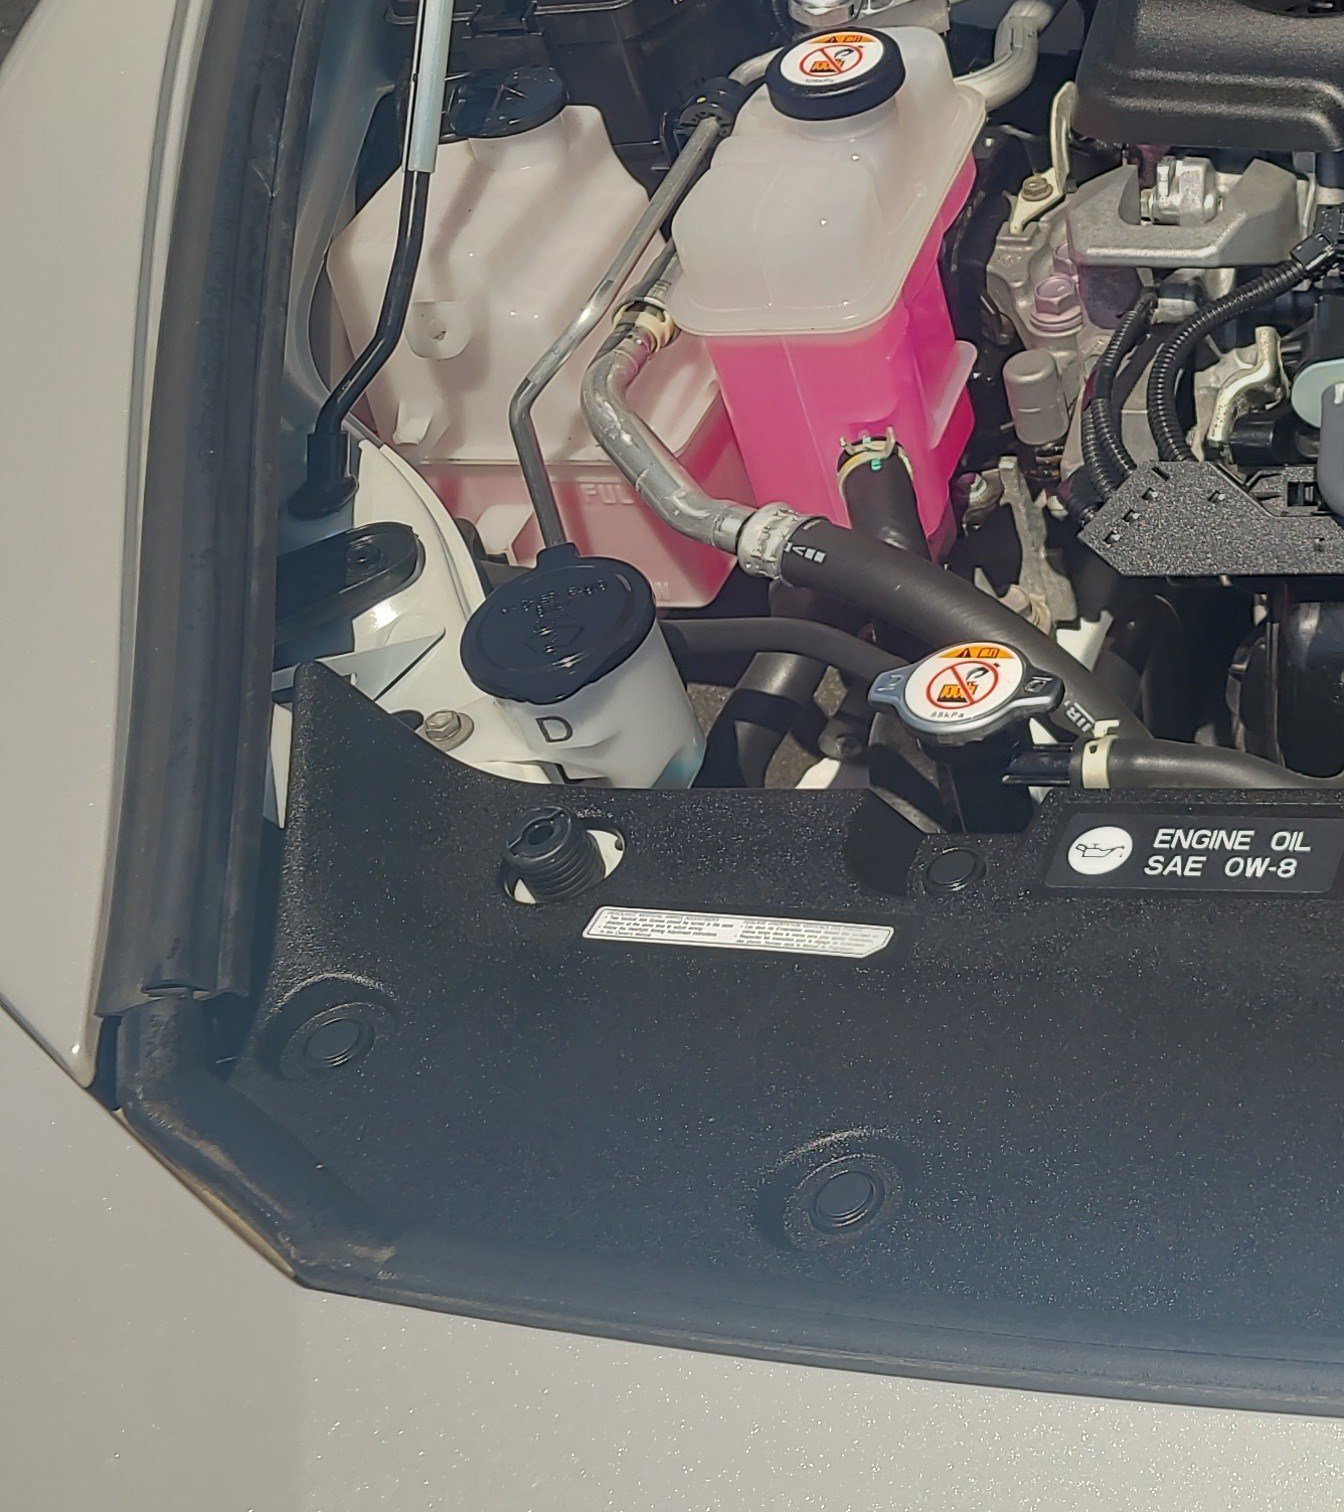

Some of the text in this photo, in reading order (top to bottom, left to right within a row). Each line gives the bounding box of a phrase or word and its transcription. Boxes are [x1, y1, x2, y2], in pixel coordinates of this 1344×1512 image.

[1153, 828, 1312, 853] ENGINE OIL
[1144, 855, 1298, 878] SAE 0W-8
